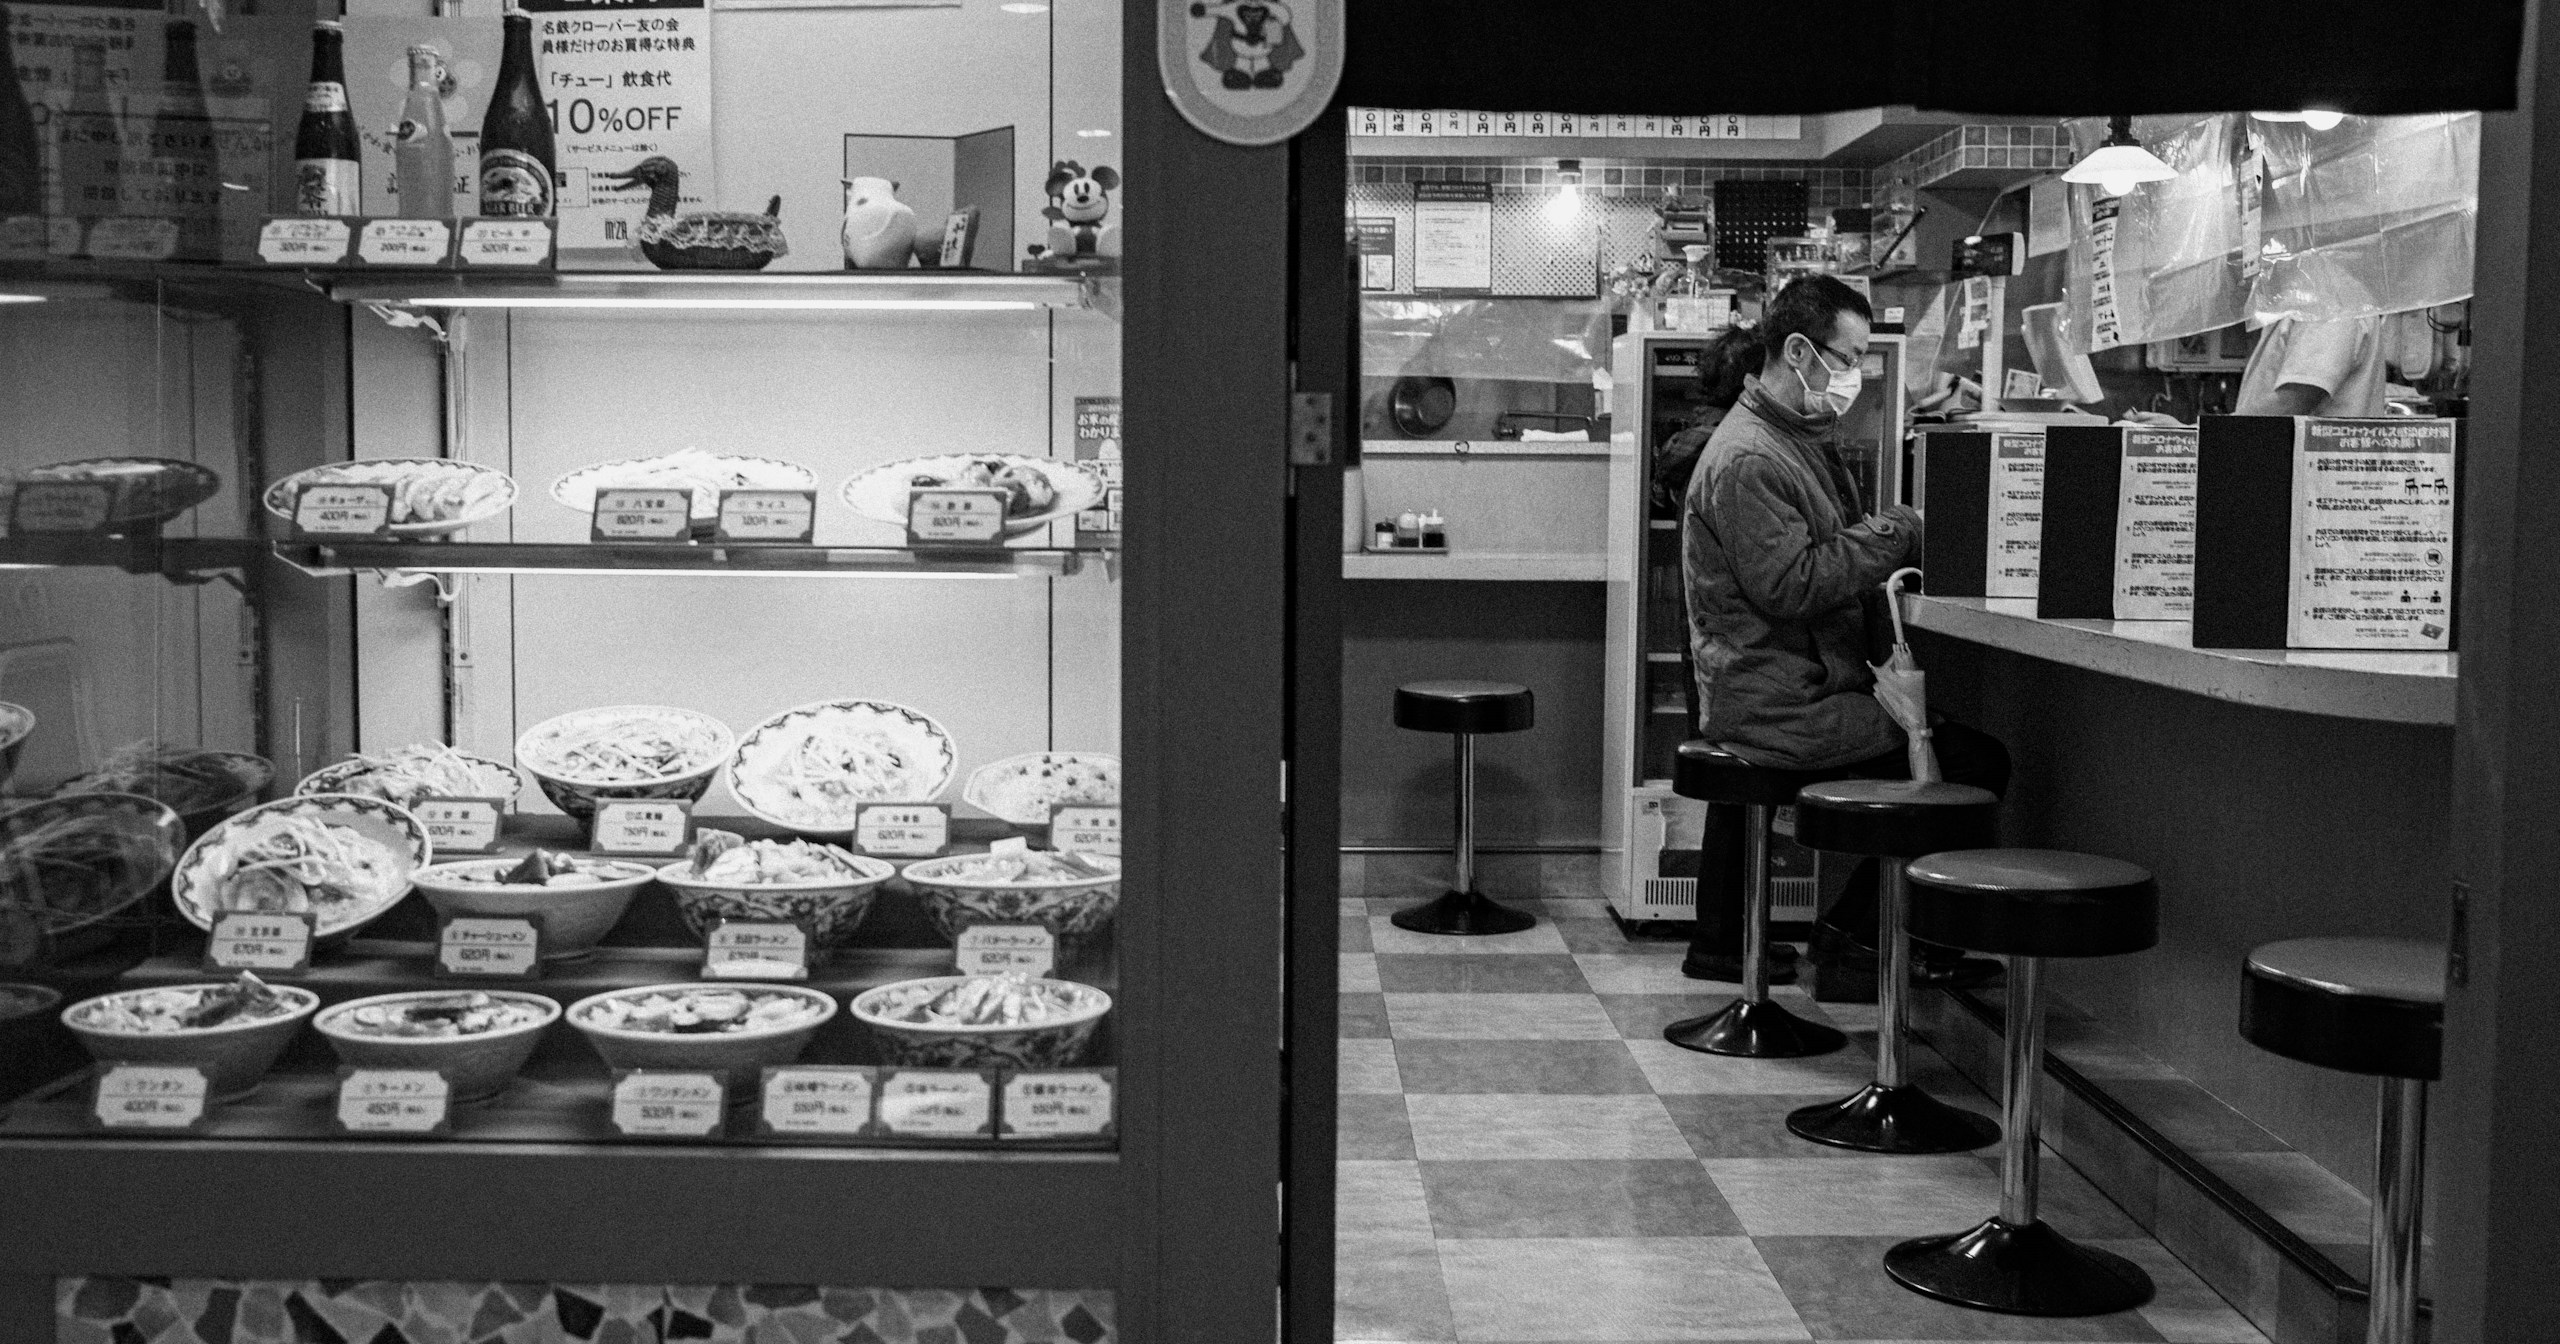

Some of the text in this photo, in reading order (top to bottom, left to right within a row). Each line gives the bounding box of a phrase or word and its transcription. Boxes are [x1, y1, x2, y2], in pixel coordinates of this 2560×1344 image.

[542, 17, 680, 34] 名鉄クローバー友の会
[542, 37, 695, 54] 員様だけのお買得な特典
[622, 70, 672, 88] 飲食代
[546, 98, 682, 134] 10%OFF
[2311, 426, 2450, 438] 新型コロナウイルス感染症対策
[378, 1082, 426, 1094] ラーメン
